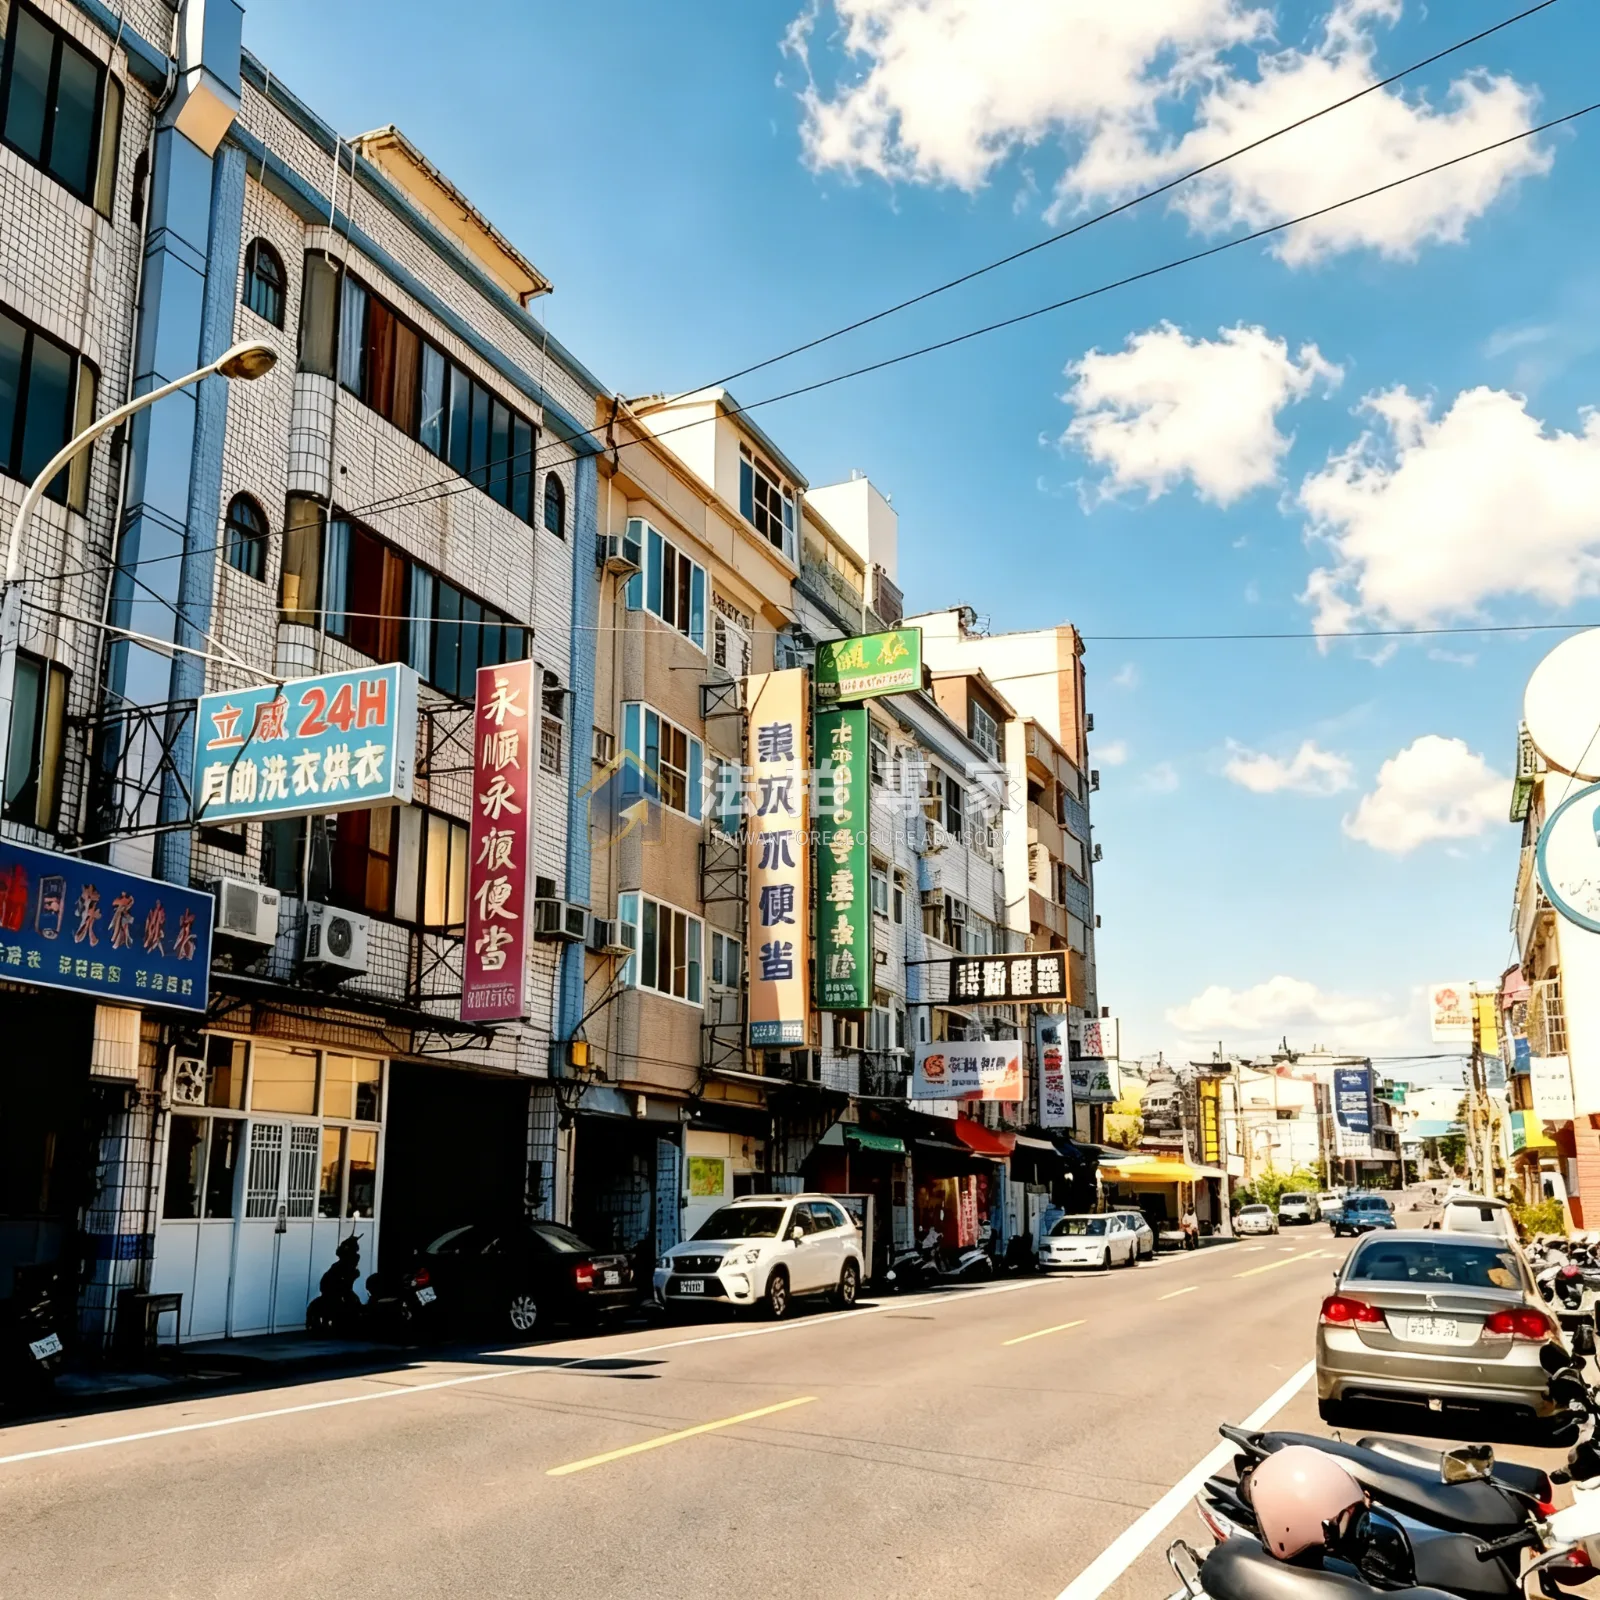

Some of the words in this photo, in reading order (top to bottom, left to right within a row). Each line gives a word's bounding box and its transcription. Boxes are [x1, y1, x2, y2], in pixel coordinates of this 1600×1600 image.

[296, 679, 389, 739] 24H
[200, 740, 386, 806] 自助洗衣烘衣
